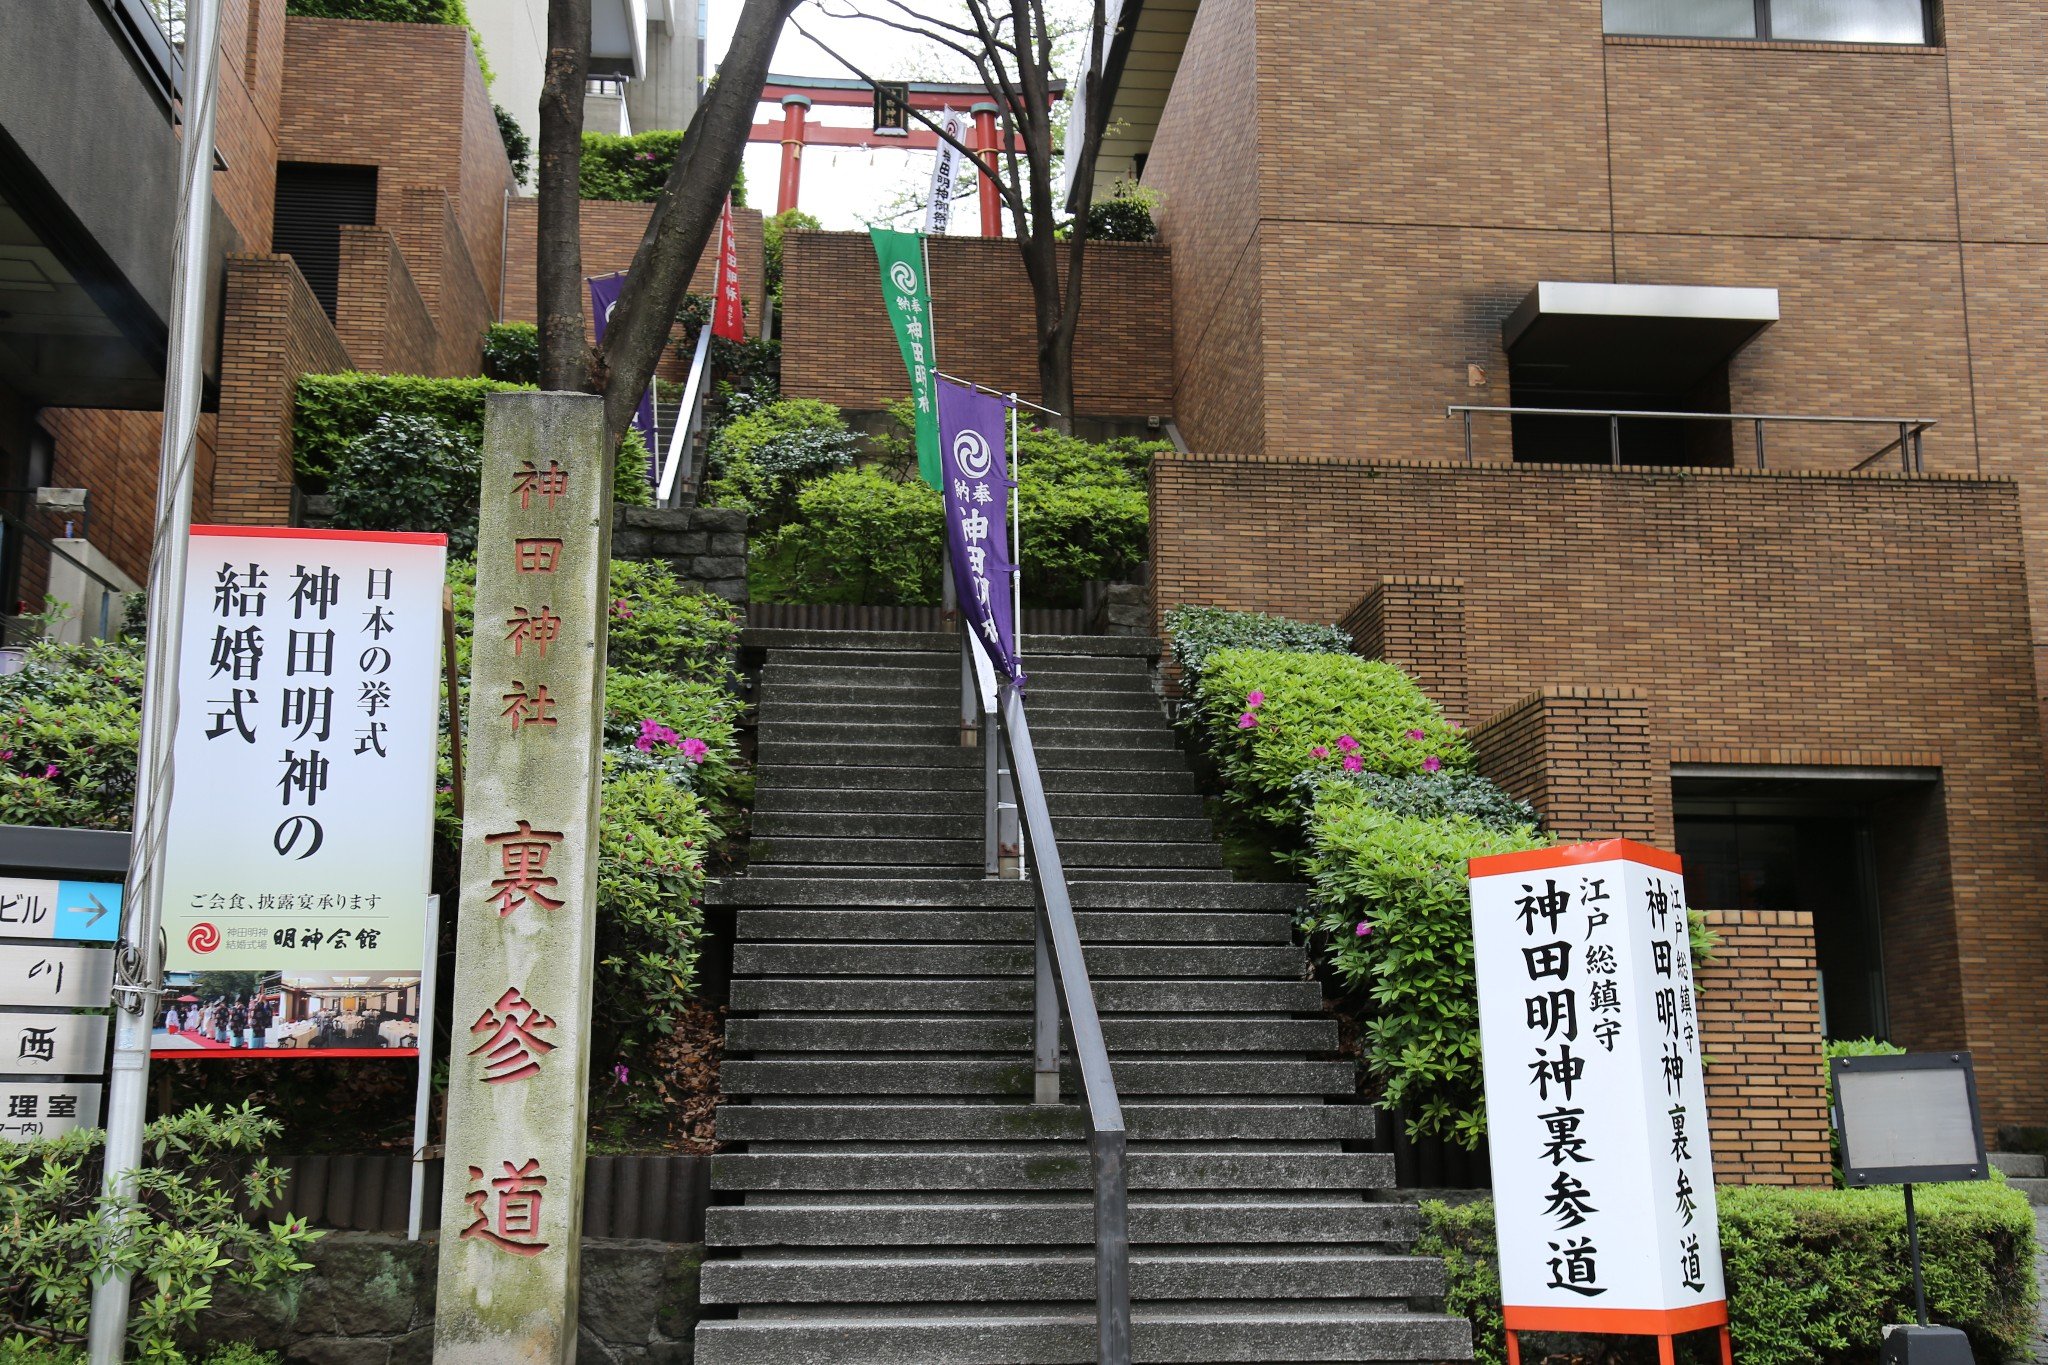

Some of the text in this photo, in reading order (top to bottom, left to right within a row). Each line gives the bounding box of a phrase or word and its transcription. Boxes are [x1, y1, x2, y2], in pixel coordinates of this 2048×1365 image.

[204, 562, 269, 744] 結婚式
[354, 567, 395, 758] 日本の挙式
[499, 459, 569, 731] 神田神社
[273, 564, 341, 861] 神田明神の
[0, 893, 47, 924] ビル
[190, 893, 381, 910] ご会食、披露宴承ります
[226, 928, 268, 938] 神田明神
[226, 940, 268, 950] 結婚式場
[273, 927, 381, 950] 明神会館
[1580, 877, 1622, 1053] 江戸総鎮守
[1670, 883, 1693, 1054] 江戸総鎮守
[7, 1094, 78, 1118] 理室
[1514, 879, 1609, 1298] 神田明神裏参道
[1645, 877, 1706, 1294] 神田明神裏参道
